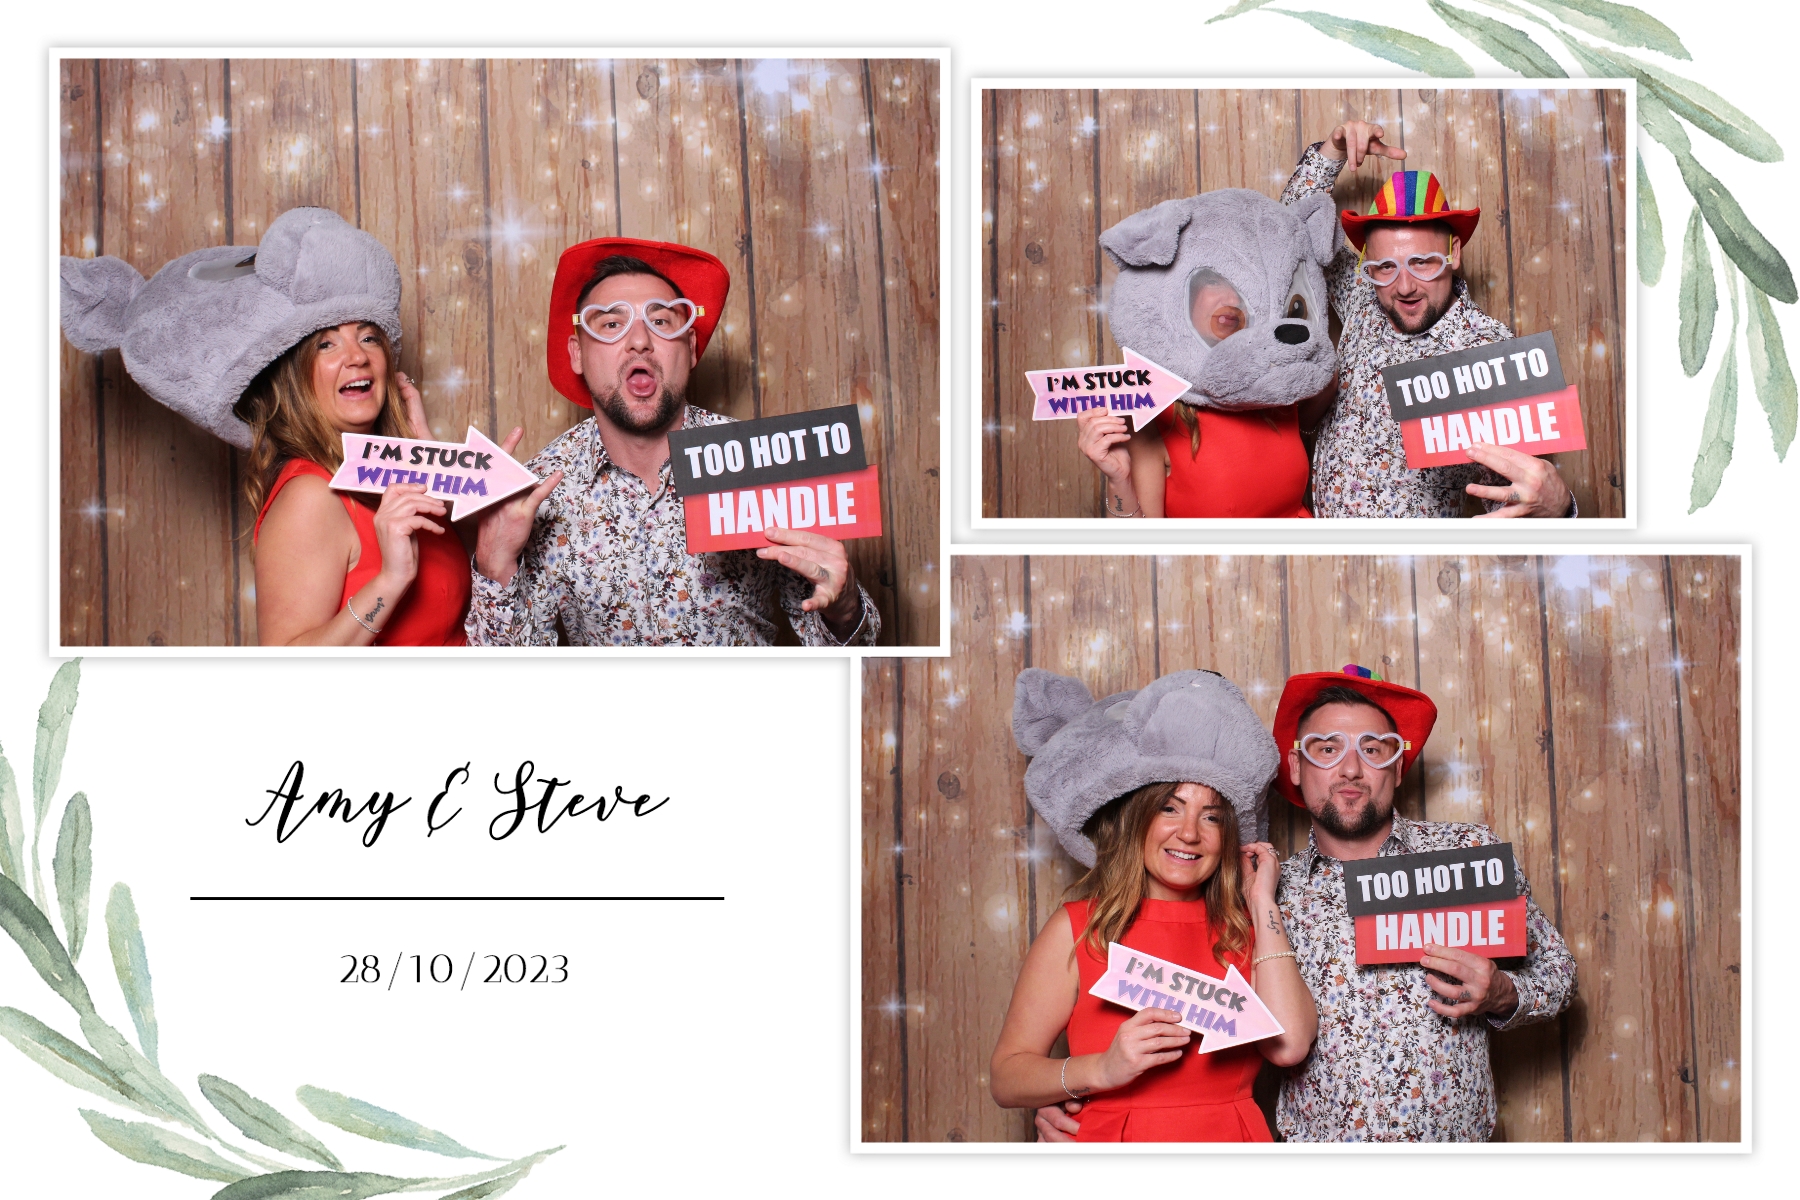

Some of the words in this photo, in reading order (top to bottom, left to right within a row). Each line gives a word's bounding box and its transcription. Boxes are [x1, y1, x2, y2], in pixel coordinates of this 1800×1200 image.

[1046, 374, 1080, 392] I'M
[1083, 369, 1152, 391] STUCK
[1396, 370, 1450, 407] TOO
[1452, 356, 1507, 395] HOT
[1509, 347, 1549, 381] TO
[1048, 395, 1106, 415] WITH
[1110, 392, 1156, 411] HIM
[1420, 401, 1561, 454] HANDLE
[362, 441, 402, 461] I'M
[409, 445, 493, 471] STUCK
[684, 440, 745, 479] TOO
[749, 429, 807, 469] HOT
[812, 422, 851, 458] TO
[357, 465, 429, 487] WITH
[432, 473, 489, 497] HIM
[708, 482, 857, 536] HANDLE
[1357, 870, 1409, 902] TOO
[1414, 862, 1465, 896] HOT
[1470, 857, 1504, 888] TO
[1375, 910, 1505, 951] HANDLE
[1118, 979, 1186, 1014] WITH
[1185, 1003, 1238, 1037] HIM
[1125, 956, 1164, 984] I'M
[1169, 971, 1248, 1013] STUCK
